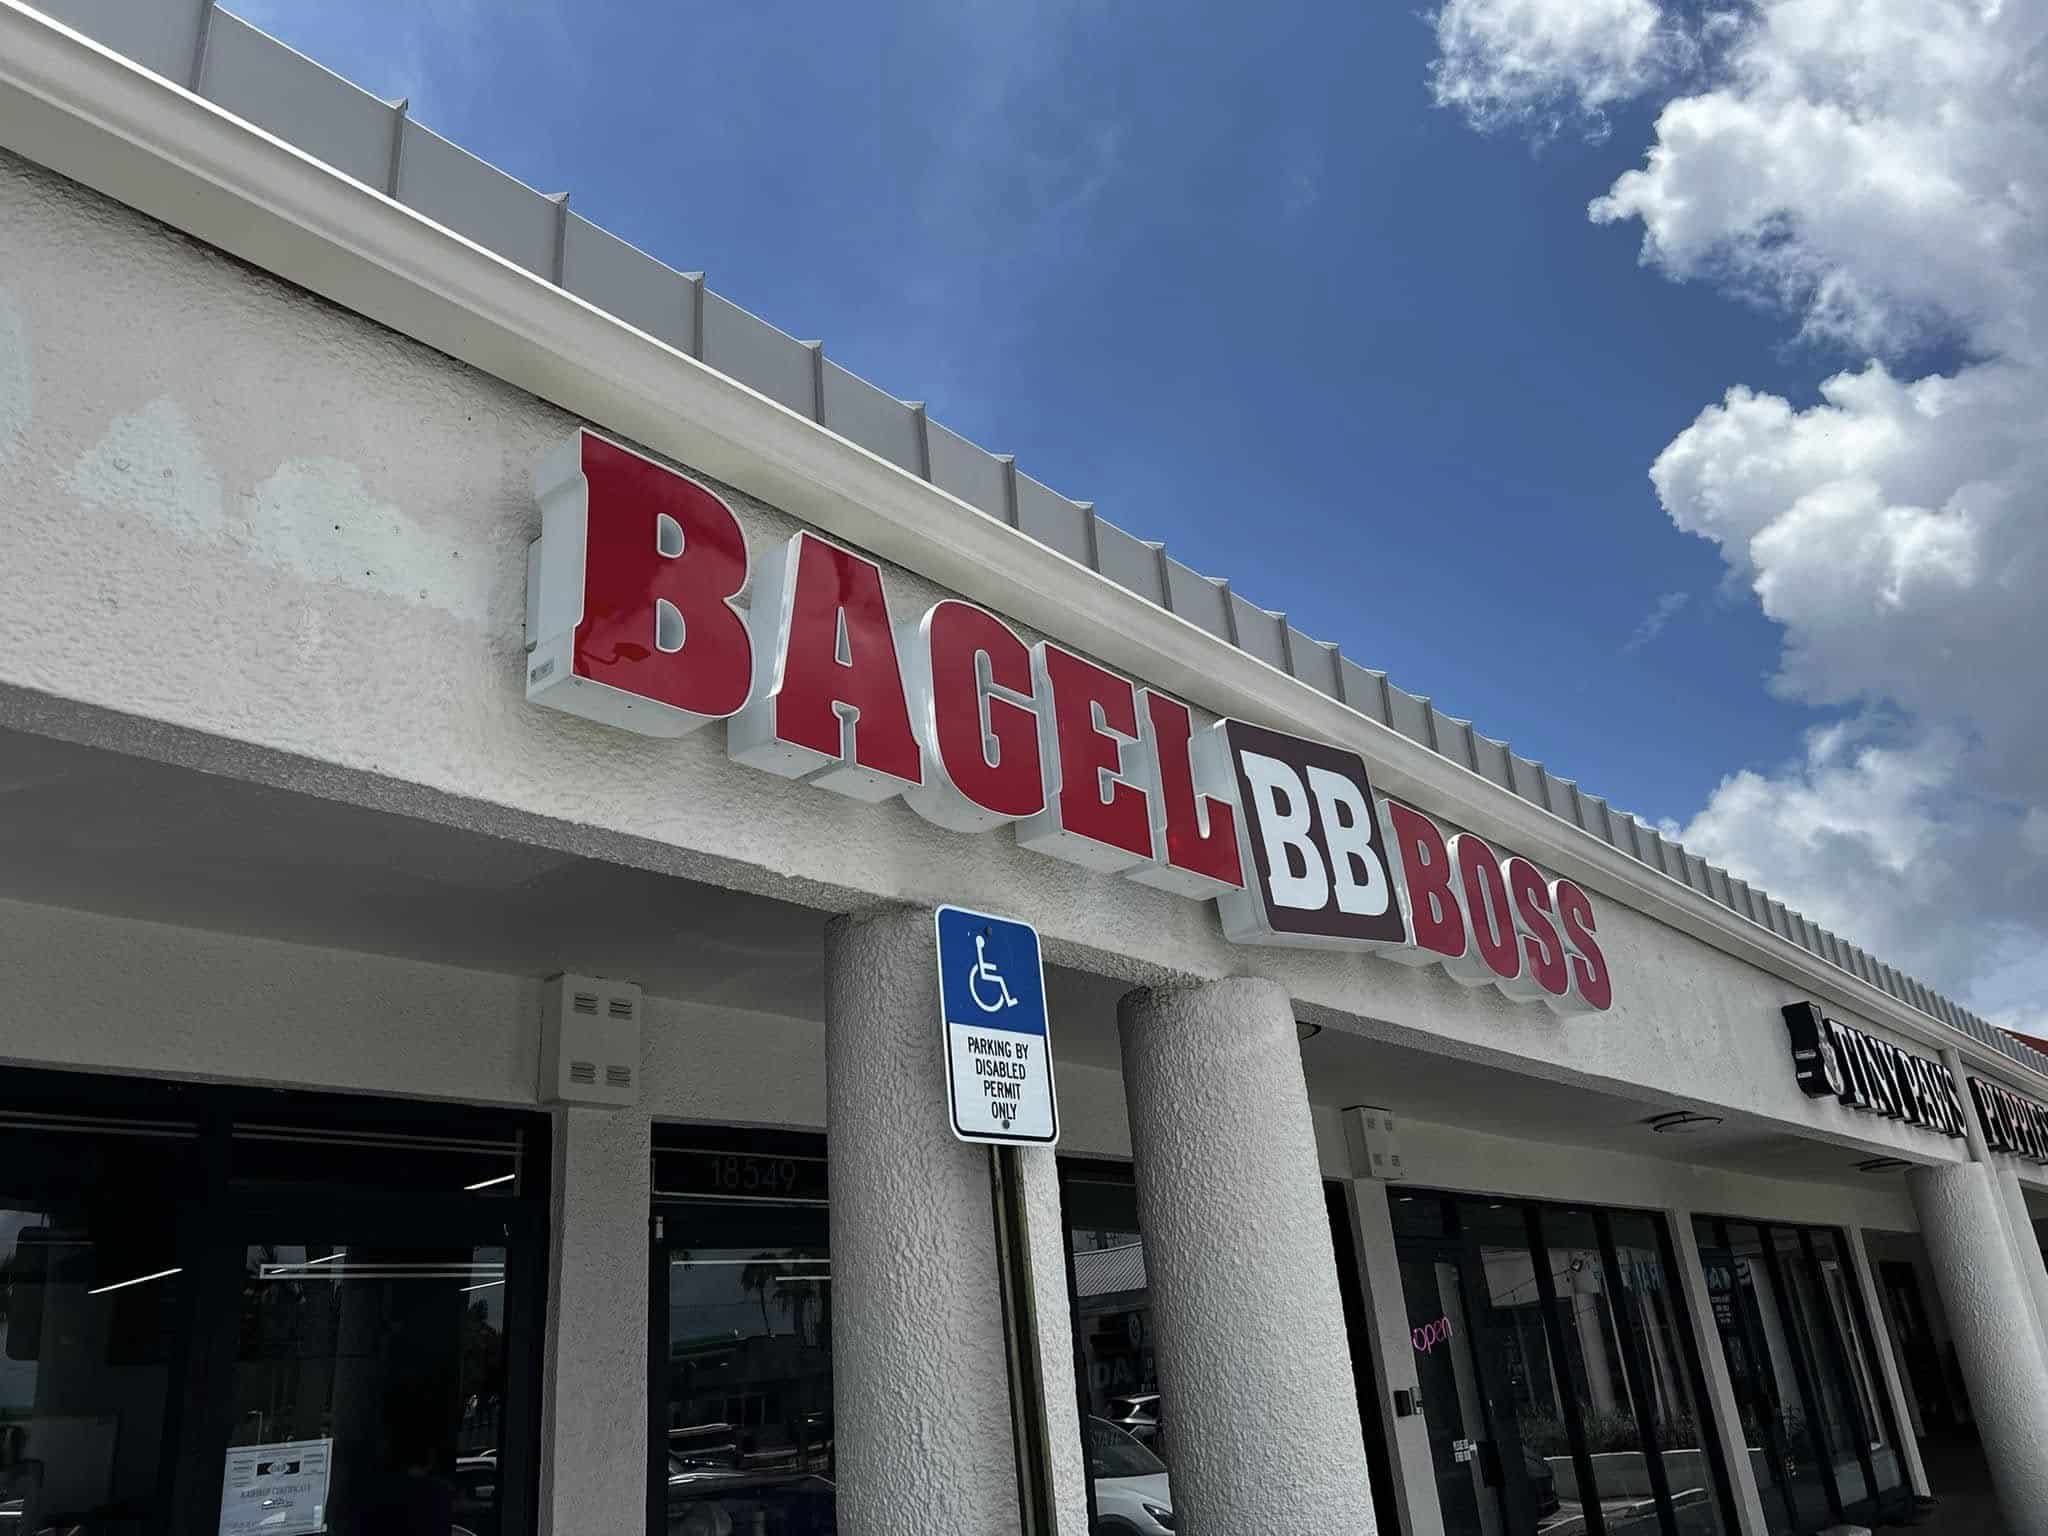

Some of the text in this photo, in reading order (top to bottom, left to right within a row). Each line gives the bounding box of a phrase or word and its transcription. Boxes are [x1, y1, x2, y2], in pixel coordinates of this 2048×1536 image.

[571, 427, 1613, 1011] BAGEL BB BOSS
[967, 1036, 1029, 1060] PARKING BY
[975, 1058, 1026, 1080] DISABLED
[1828, 1019, 1911, 1120] TINY
[1897, 1049, 1968, 1138] PAWS
[983, 1079, 1021, 1101] PERMIT
[991, 1101, 1017, 1120] ONLY
[712, 1159, 797, 1193] 18549
[1411, 1316, 1453, 1354] open
